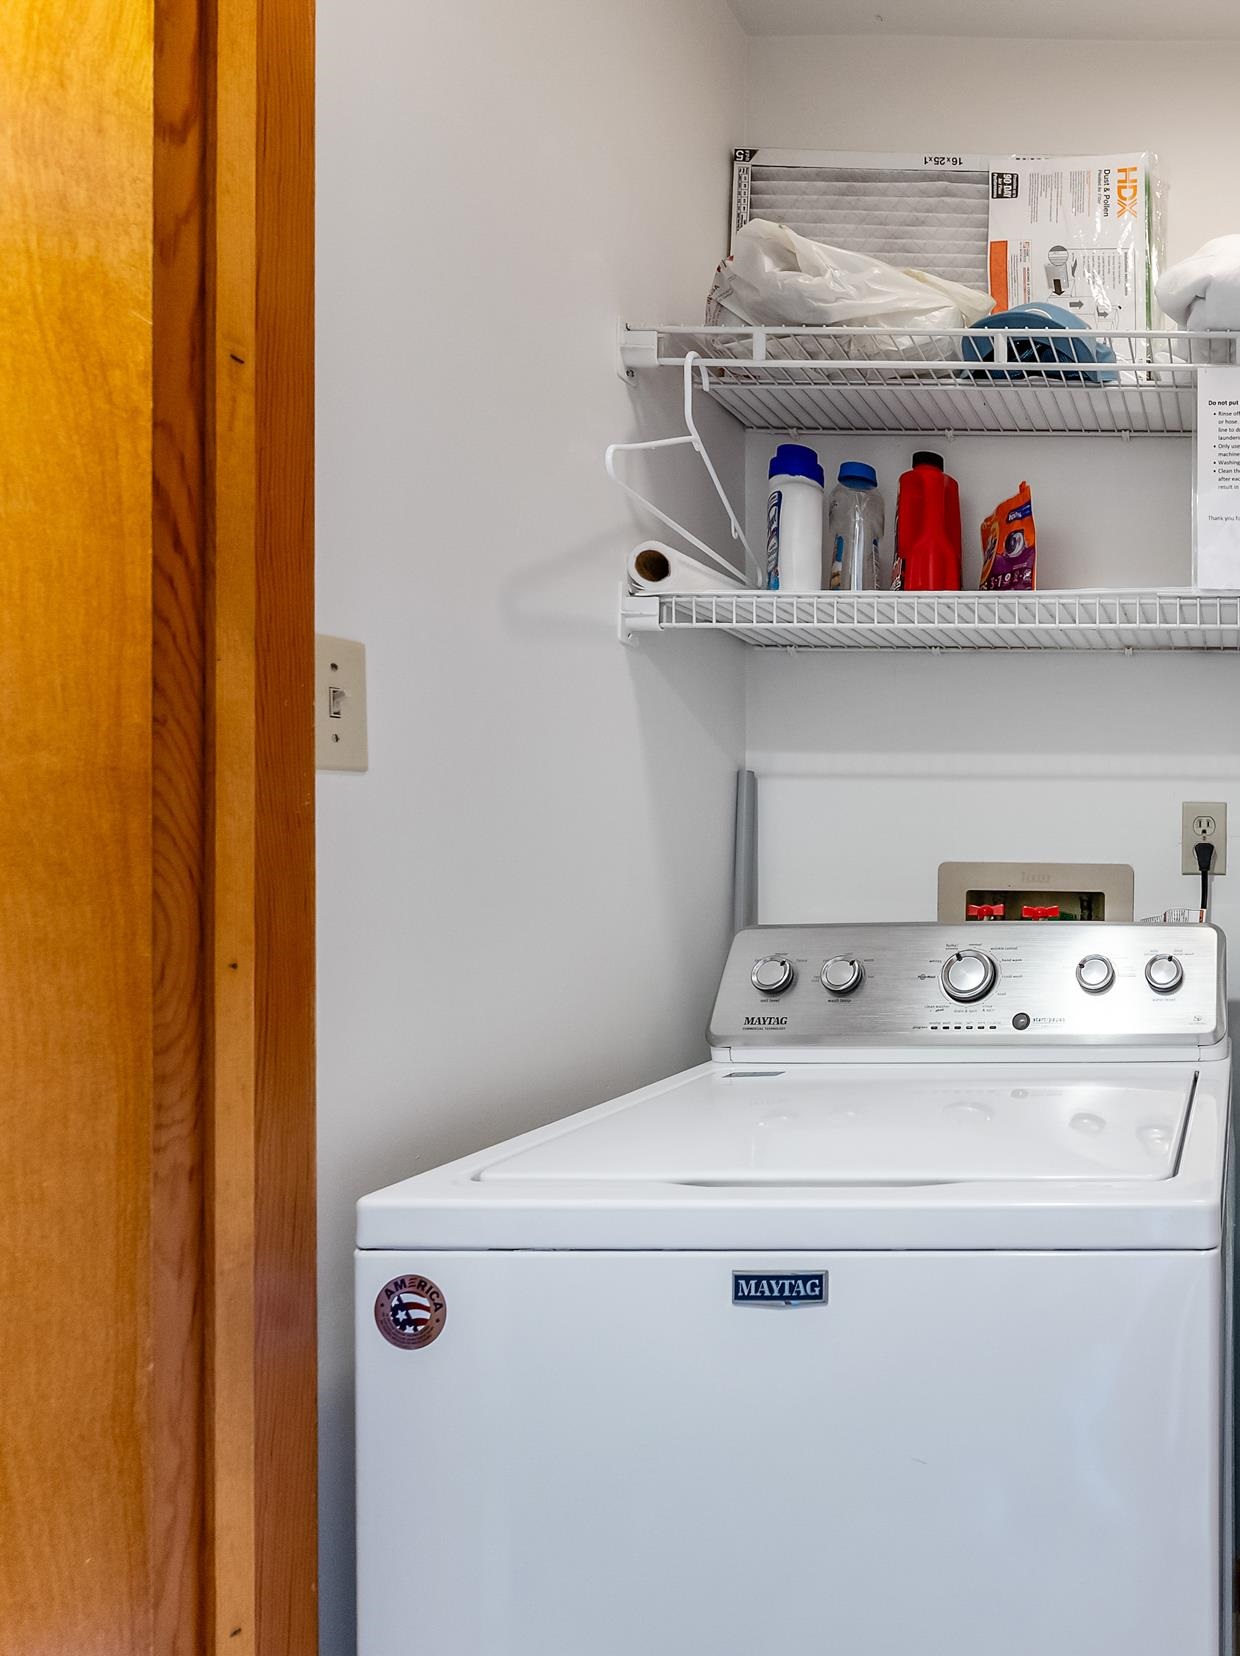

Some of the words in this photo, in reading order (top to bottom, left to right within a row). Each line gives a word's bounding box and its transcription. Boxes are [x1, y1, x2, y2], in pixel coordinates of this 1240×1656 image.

[736, 150, 744, 161] 5
[924, 156, 964, 166] 16x25x1
[1116, 166, 1138, 218] HDX
[744, 1017, 788, 1026] MAYTAG
[738, 1280, 820, 1296] MAYTAG
[384, 1278, 443, 1312] AMERICA
